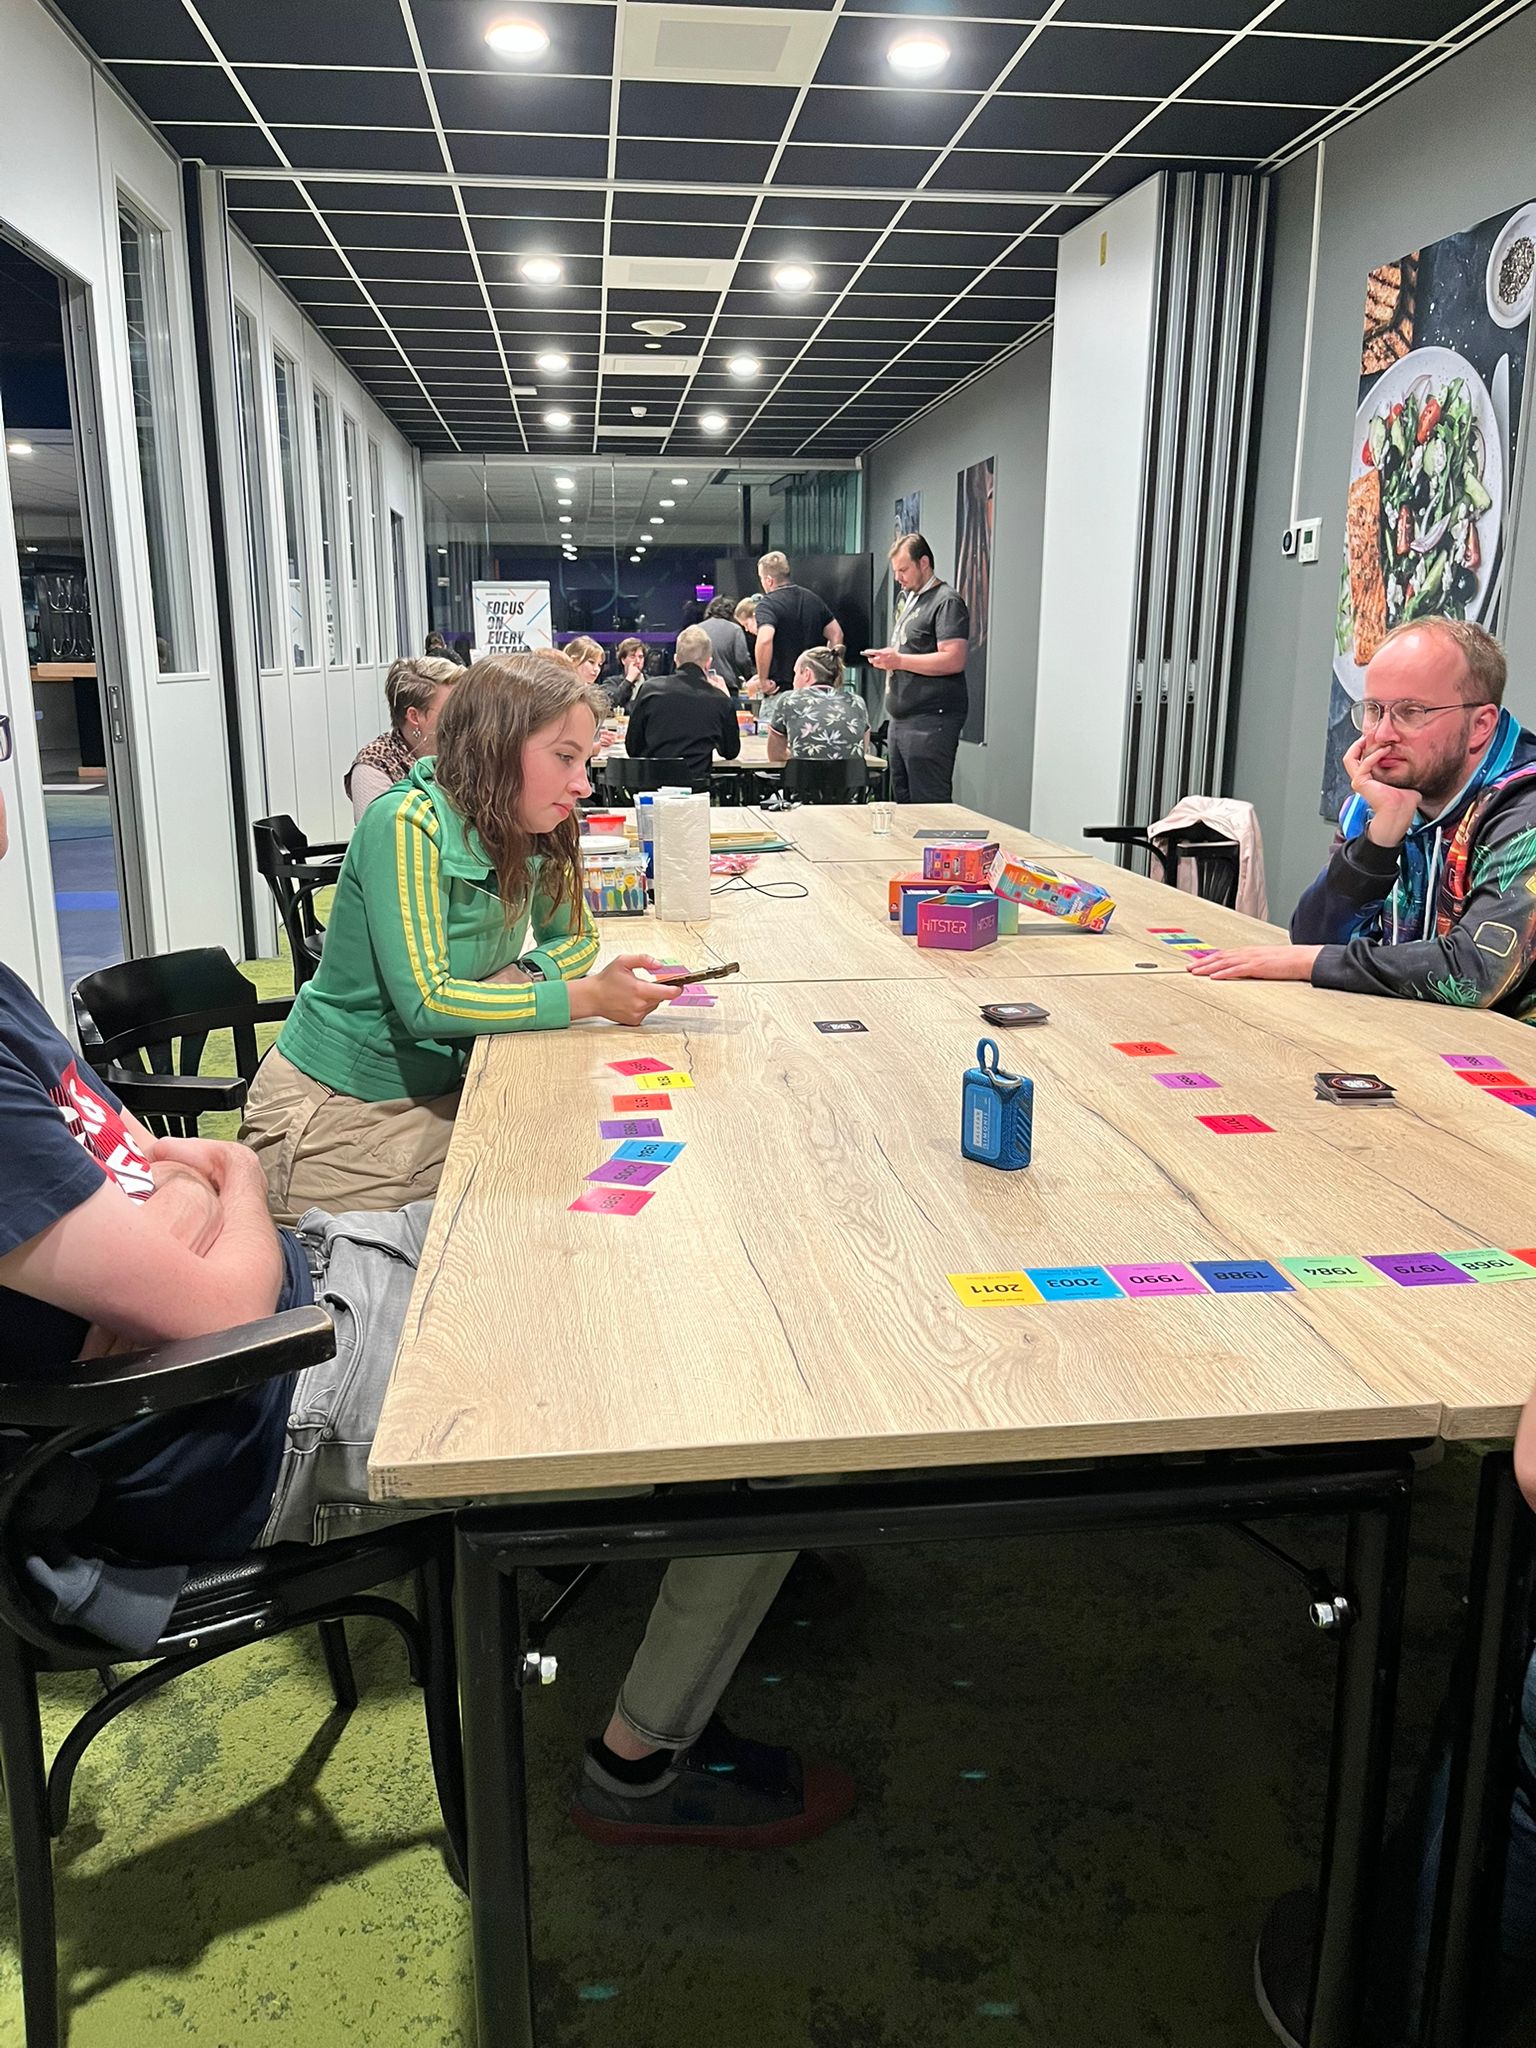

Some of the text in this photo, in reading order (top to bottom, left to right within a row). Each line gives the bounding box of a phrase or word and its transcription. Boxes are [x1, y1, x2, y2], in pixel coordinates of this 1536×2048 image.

[486, 601, 525, 616] FOCUS
[487, 616, 504, 630] ON
[487, 631, 525, 645] EVERY
[922, 918, 967, 935] HITSTER
[977, 914, 995, 930] HITSTER
[1393, 1264, 1446, 1274] 1979
[1461, 1259, 1514, 1271] 1968
[1213, 1271, 1269, 1280] 1988
[1303, 1267, 1358, 1276] 1984
[1046, 1278, 1102, 1288] 2003
[1128, 1274, 1184, 1284] 1990
[970, 1284, 1023, 1293] 2011
